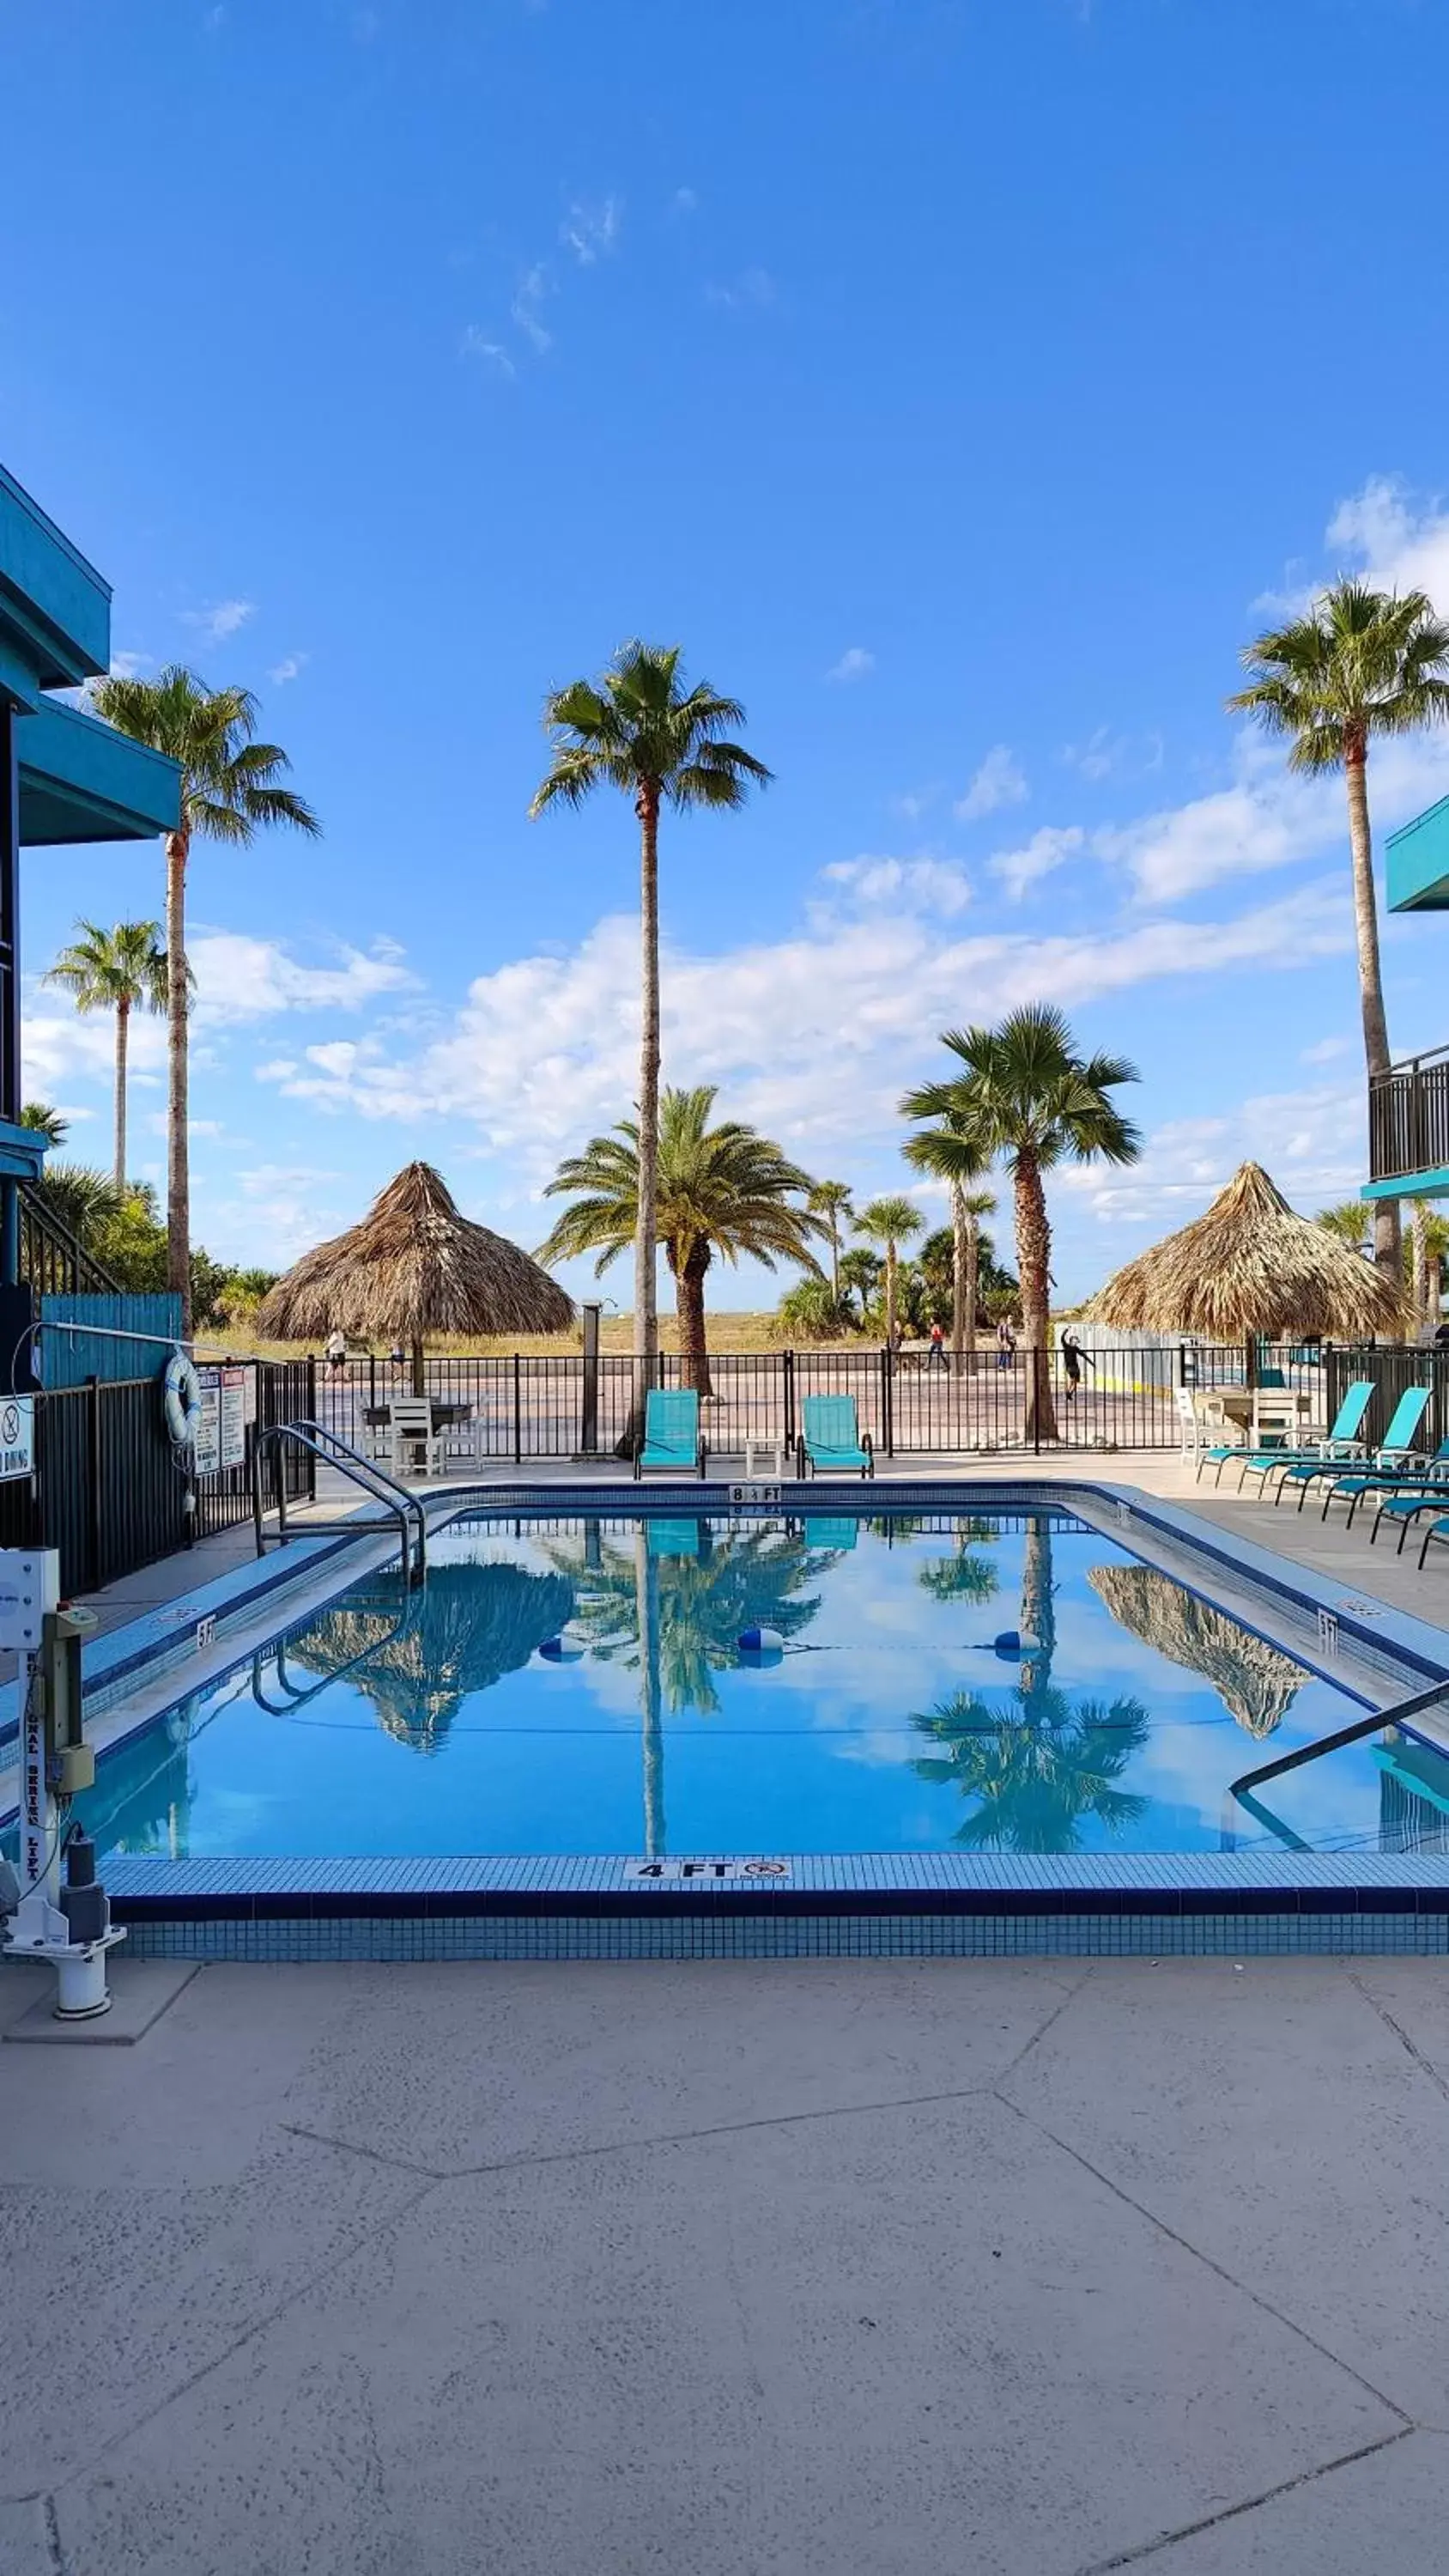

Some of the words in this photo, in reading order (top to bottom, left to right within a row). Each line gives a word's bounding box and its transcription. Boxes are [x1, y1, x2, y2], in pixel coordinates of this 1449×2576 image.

[734, 1487, 743, 1501] 8
[765, 1486, 779, 1500] FT
[27, 1837, 39, 1880] LIFT
[638, 1864, 664, 1878] 4
[682, 1863, 733, 1878] FT
